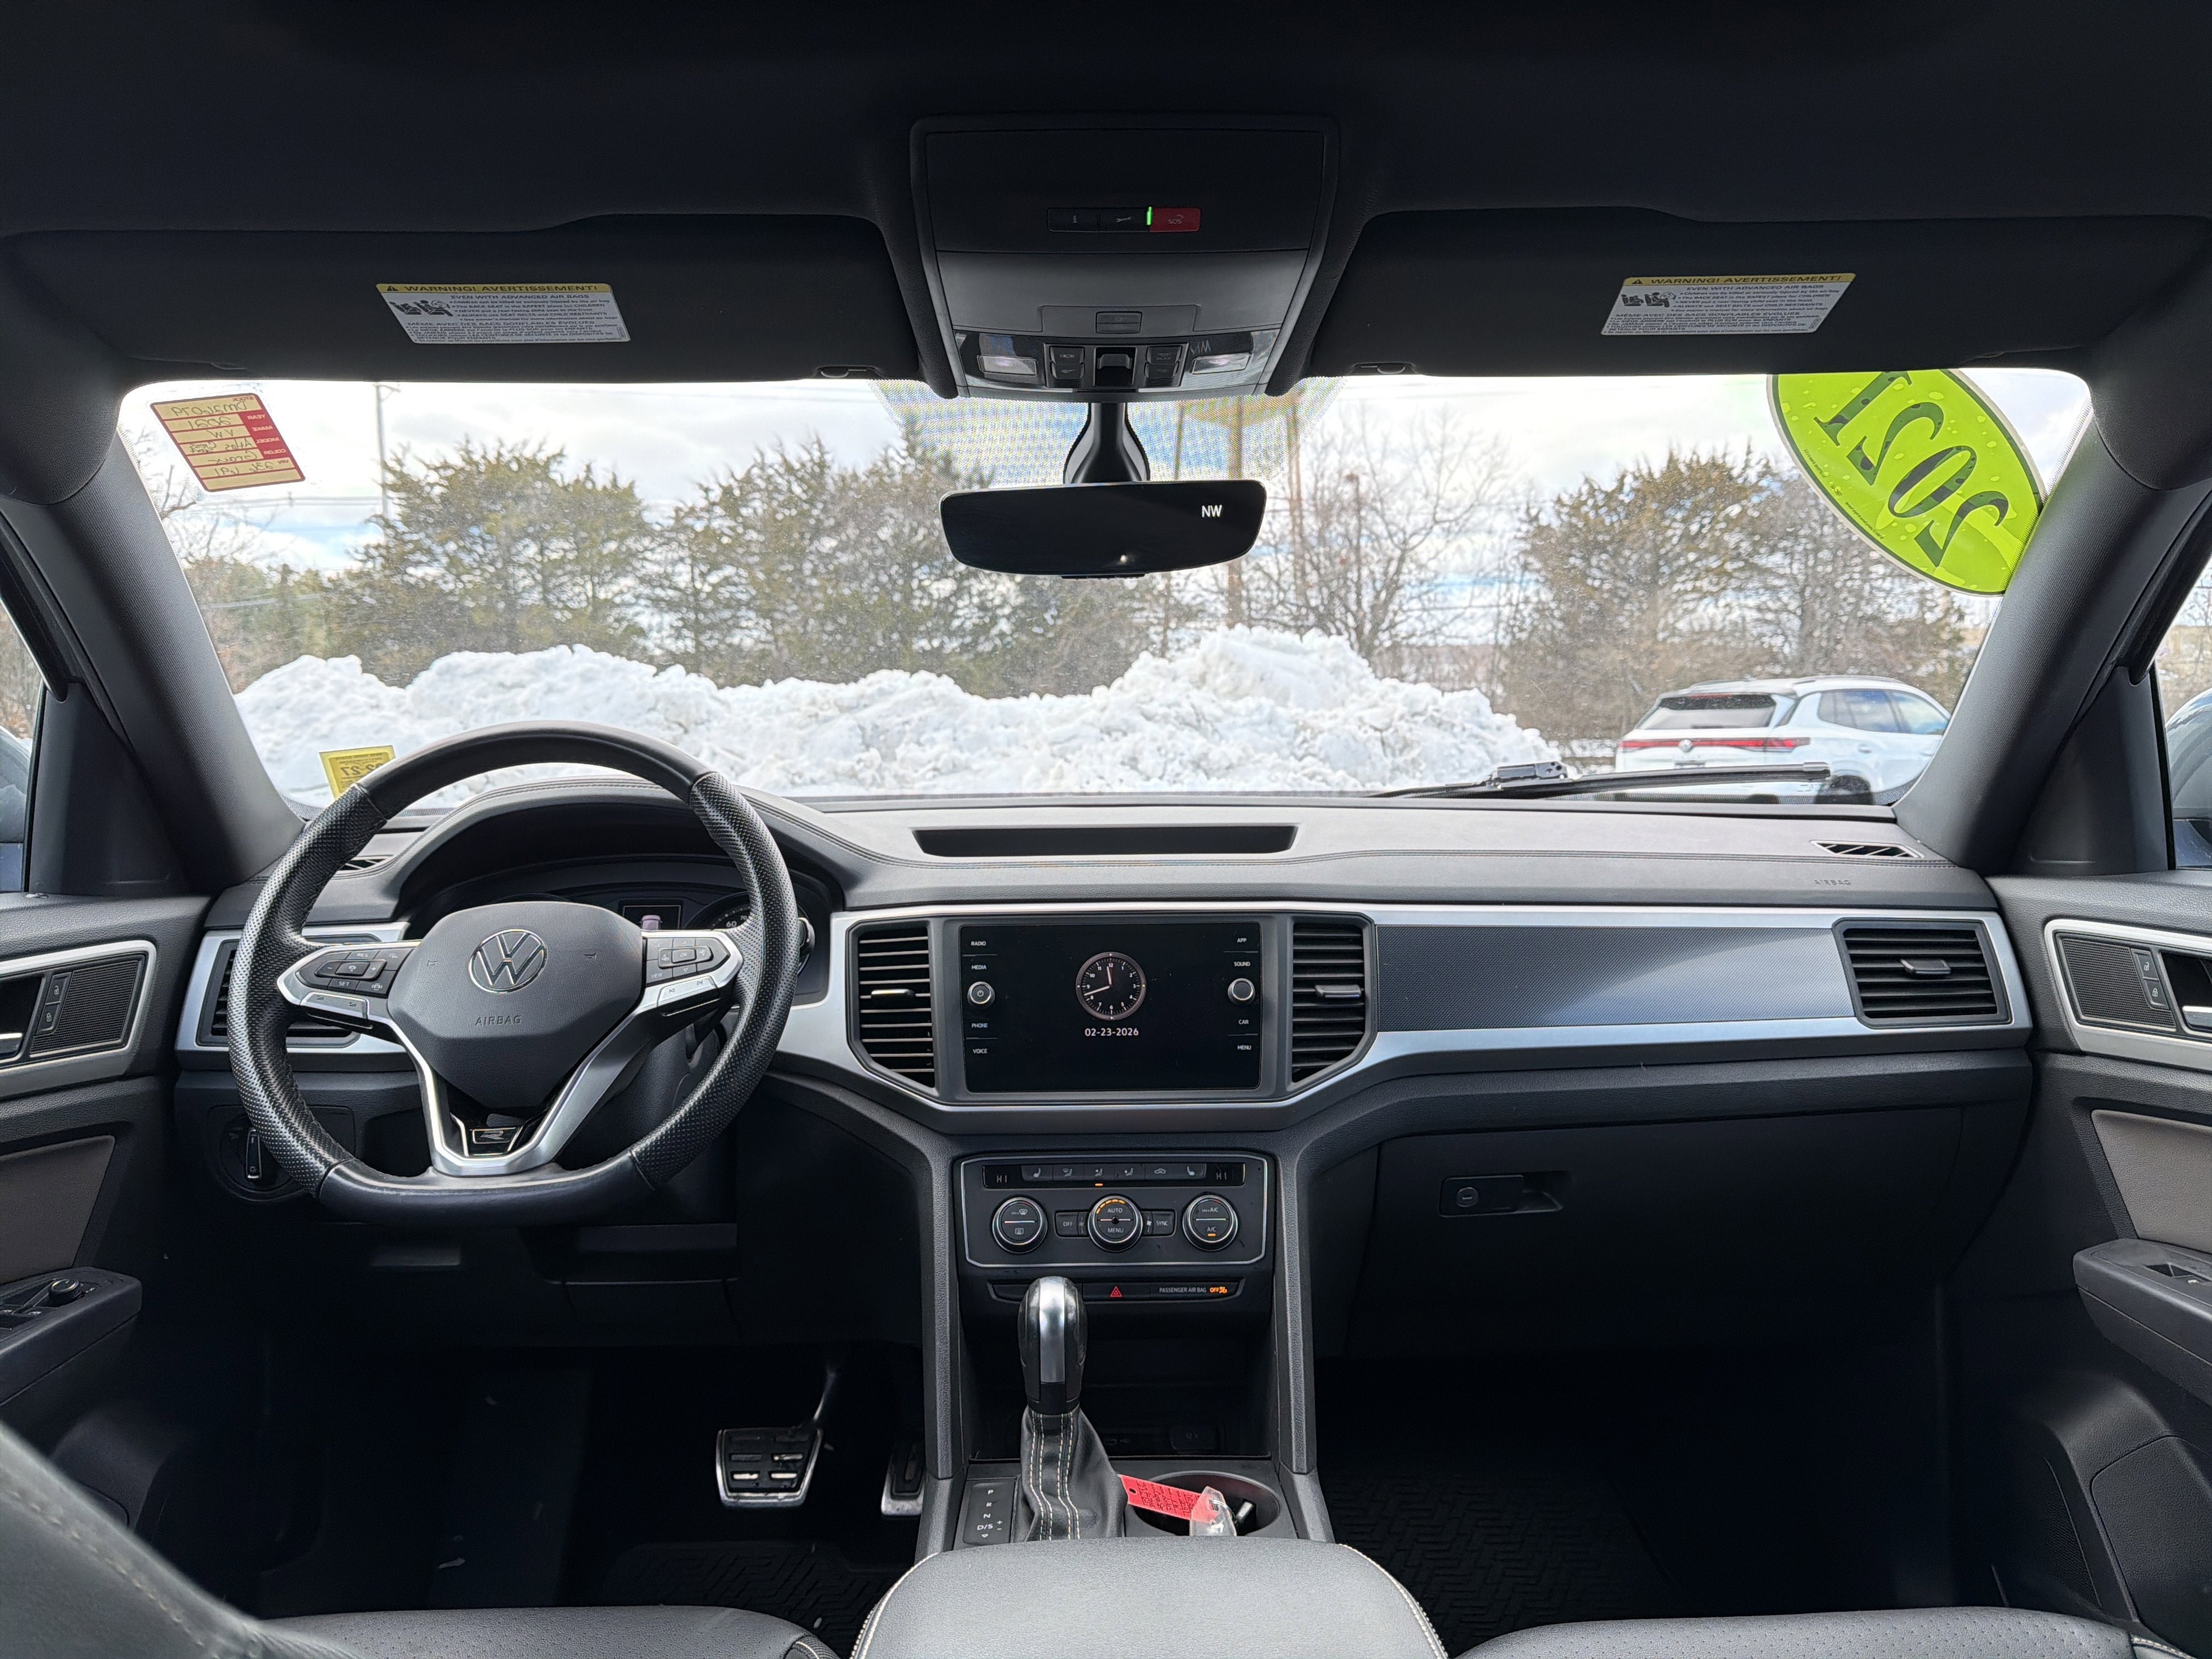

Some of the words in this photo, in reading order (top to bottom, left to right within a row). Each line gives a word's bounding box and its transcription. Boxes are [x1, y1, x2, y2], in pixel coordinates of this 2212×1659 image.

[1201, 504, 1223, 518] NW
[475, 1015, 521, 1026] AIRBAG
[1085, 1028, 1139, 1037] 02-23-2026
